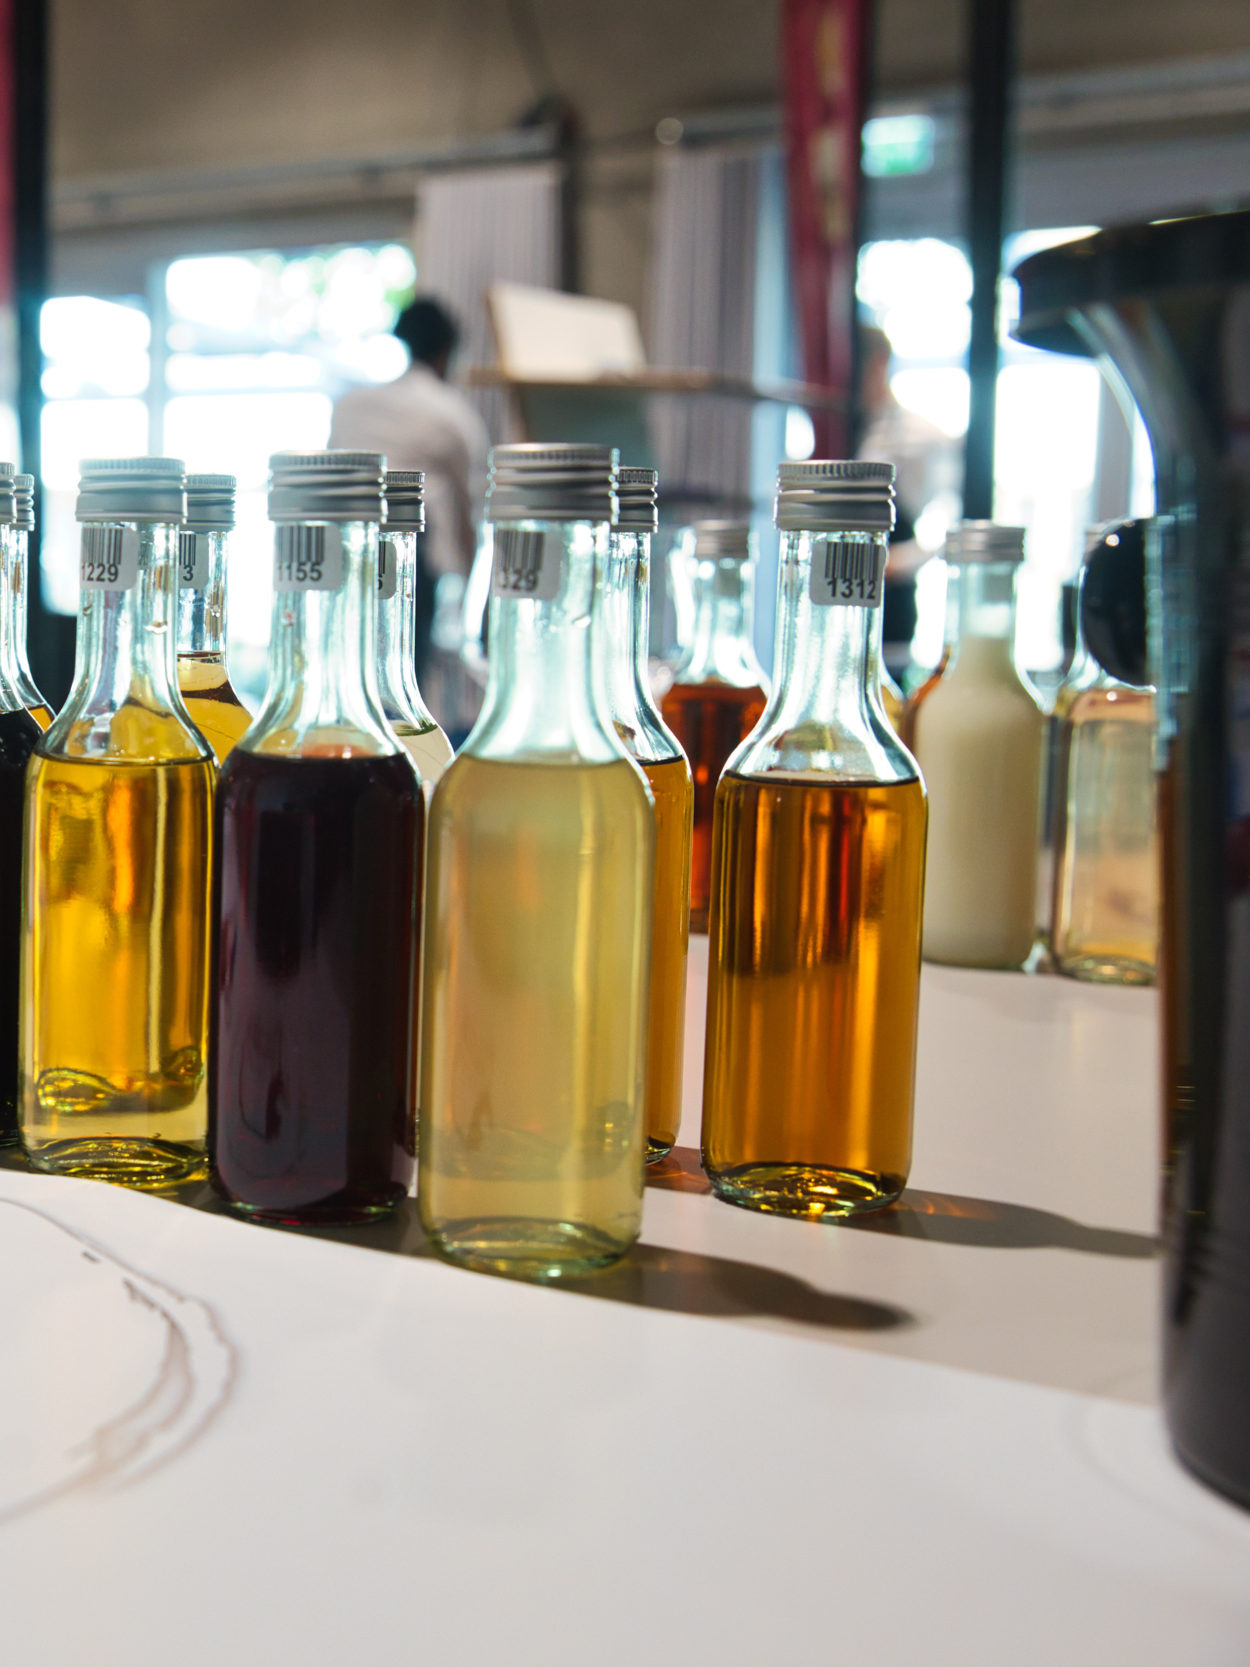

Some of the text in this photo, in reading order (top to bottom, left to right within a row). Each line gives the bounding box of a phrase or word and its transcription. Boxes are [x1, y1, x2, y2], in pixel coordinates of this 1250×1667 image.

[81, 562, 119, 582] 1229
[278, 560, 322, 581] 1155
[827, 577, 876, 600] 1312
